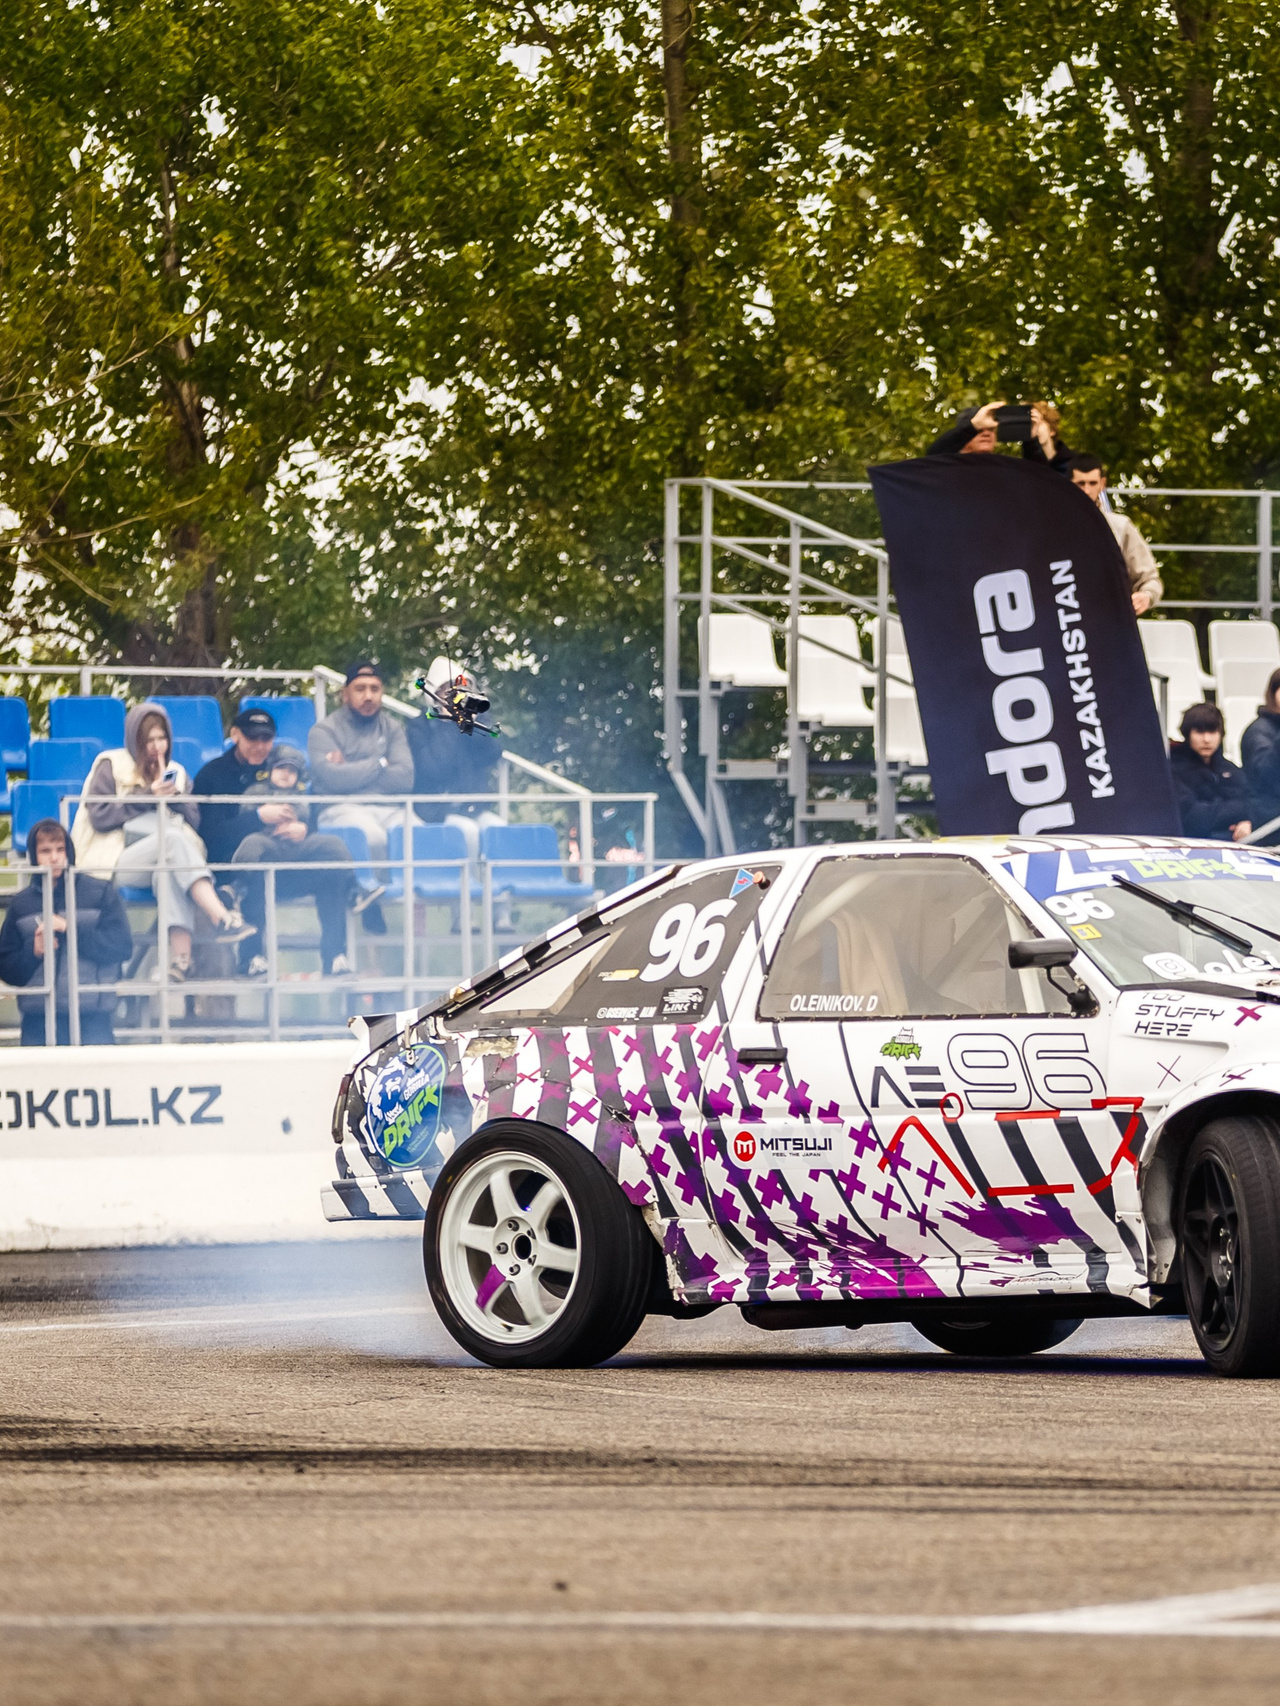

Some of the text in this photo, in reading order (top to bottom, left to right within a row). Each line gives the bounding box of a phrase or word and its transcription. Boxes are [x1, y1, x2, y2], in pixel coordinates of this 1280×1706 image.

[1049, 559, 1115, 798] KAZAKHSTAN
[1045, 891, 1115, 925] 96
[639, 898, 738, 982] 96
[790, 994, 878, 1012] OLEINIKOV. D
[1135, 1003, 1225, 1021] STUFFY
[1134, 1020, 1193, 1037] HERE
[760, 1138, 832, 1151] MITSUJI
